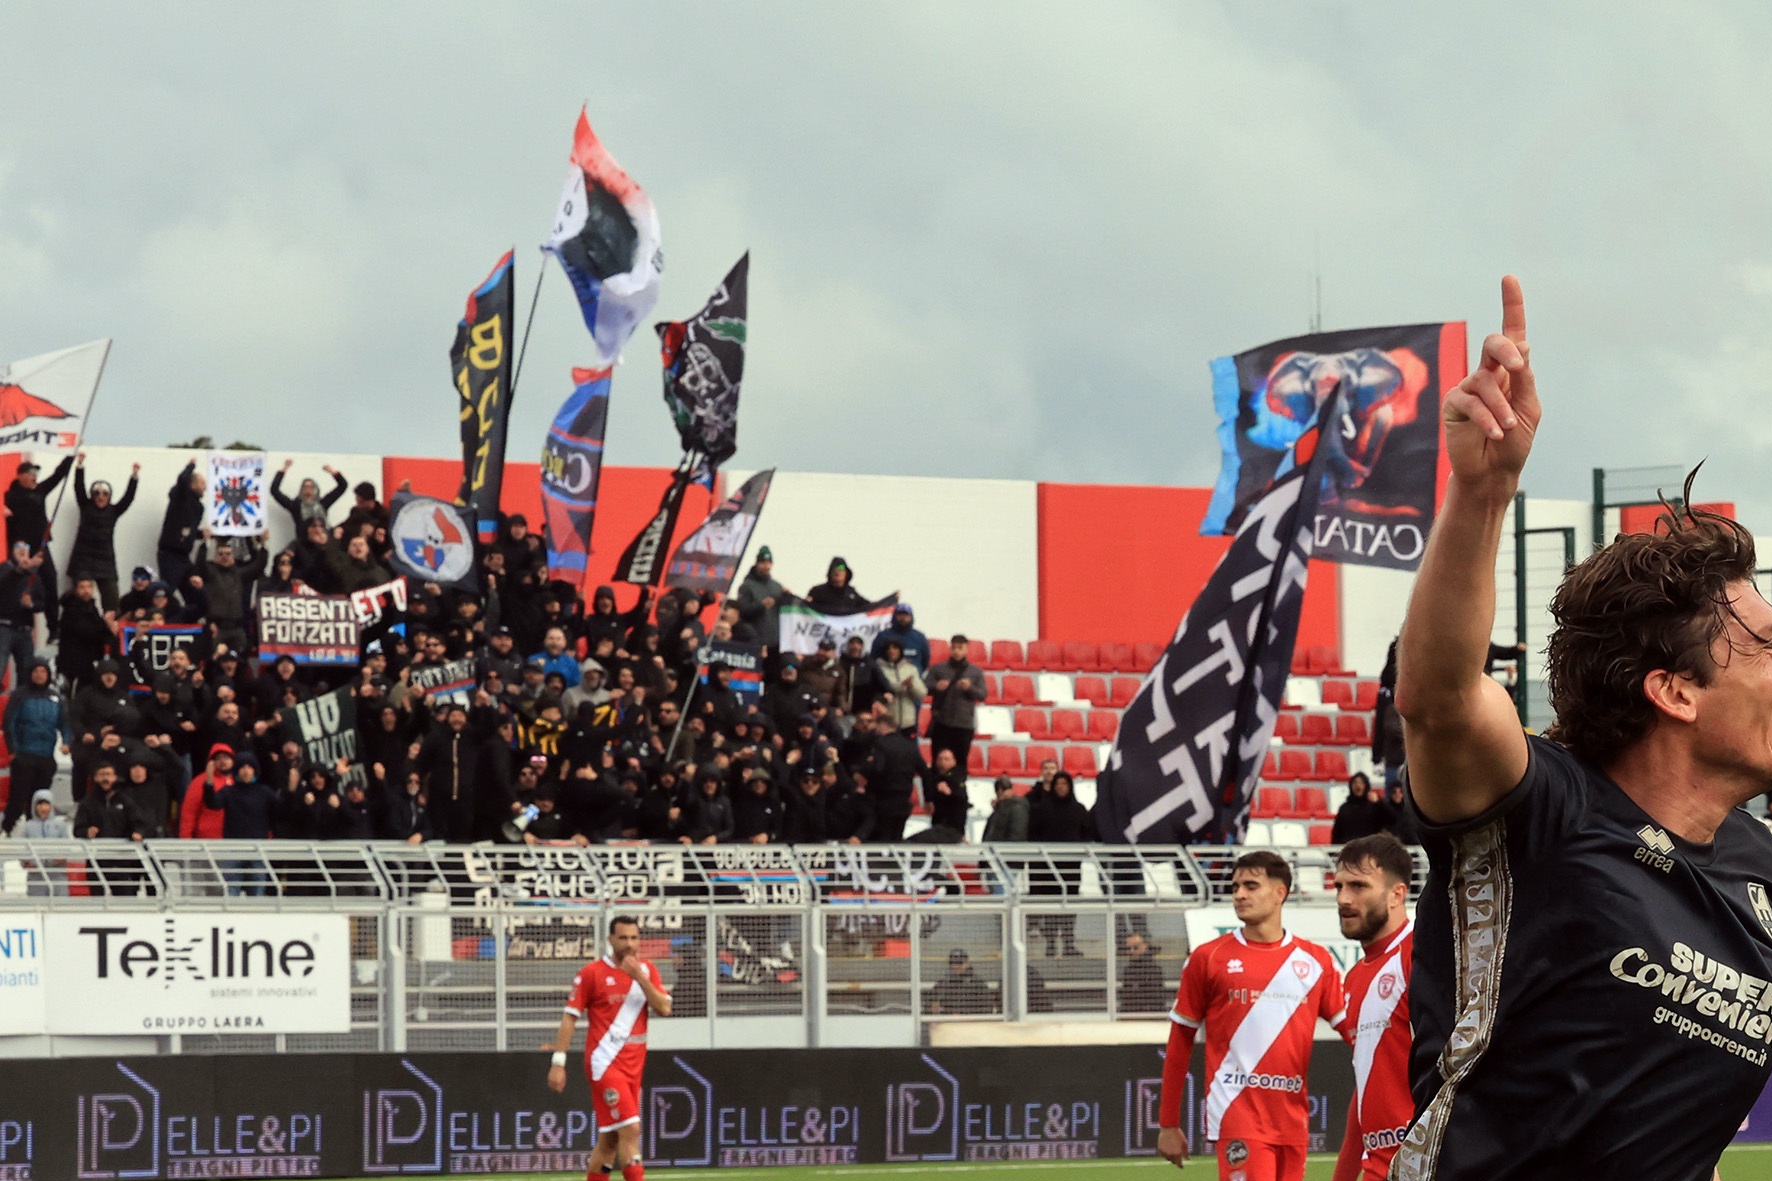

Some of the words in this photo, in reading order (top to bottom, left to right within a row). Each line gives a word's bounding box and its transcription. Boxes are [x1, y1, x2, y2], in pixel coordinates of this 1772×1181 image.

[260, 596, 355, 621] ASSENTI
[262, 620, 357, 646] FORZATI
[78, 918, 316, 989] Tekline
[210, 985, 253, 998] sistemi
[143, 1016, 207, 1029] GRUPPO
[213, 1016, 265, 1029] LAERA
[1652, 1005, 1768, 1068] gruppoarena.it
[166, 1114, 322, 1156] ELLE&PI
[718, 1105, 860, 1146] ELLE&PI
[965, 1101, 1099, 1141] ELLE&PI
